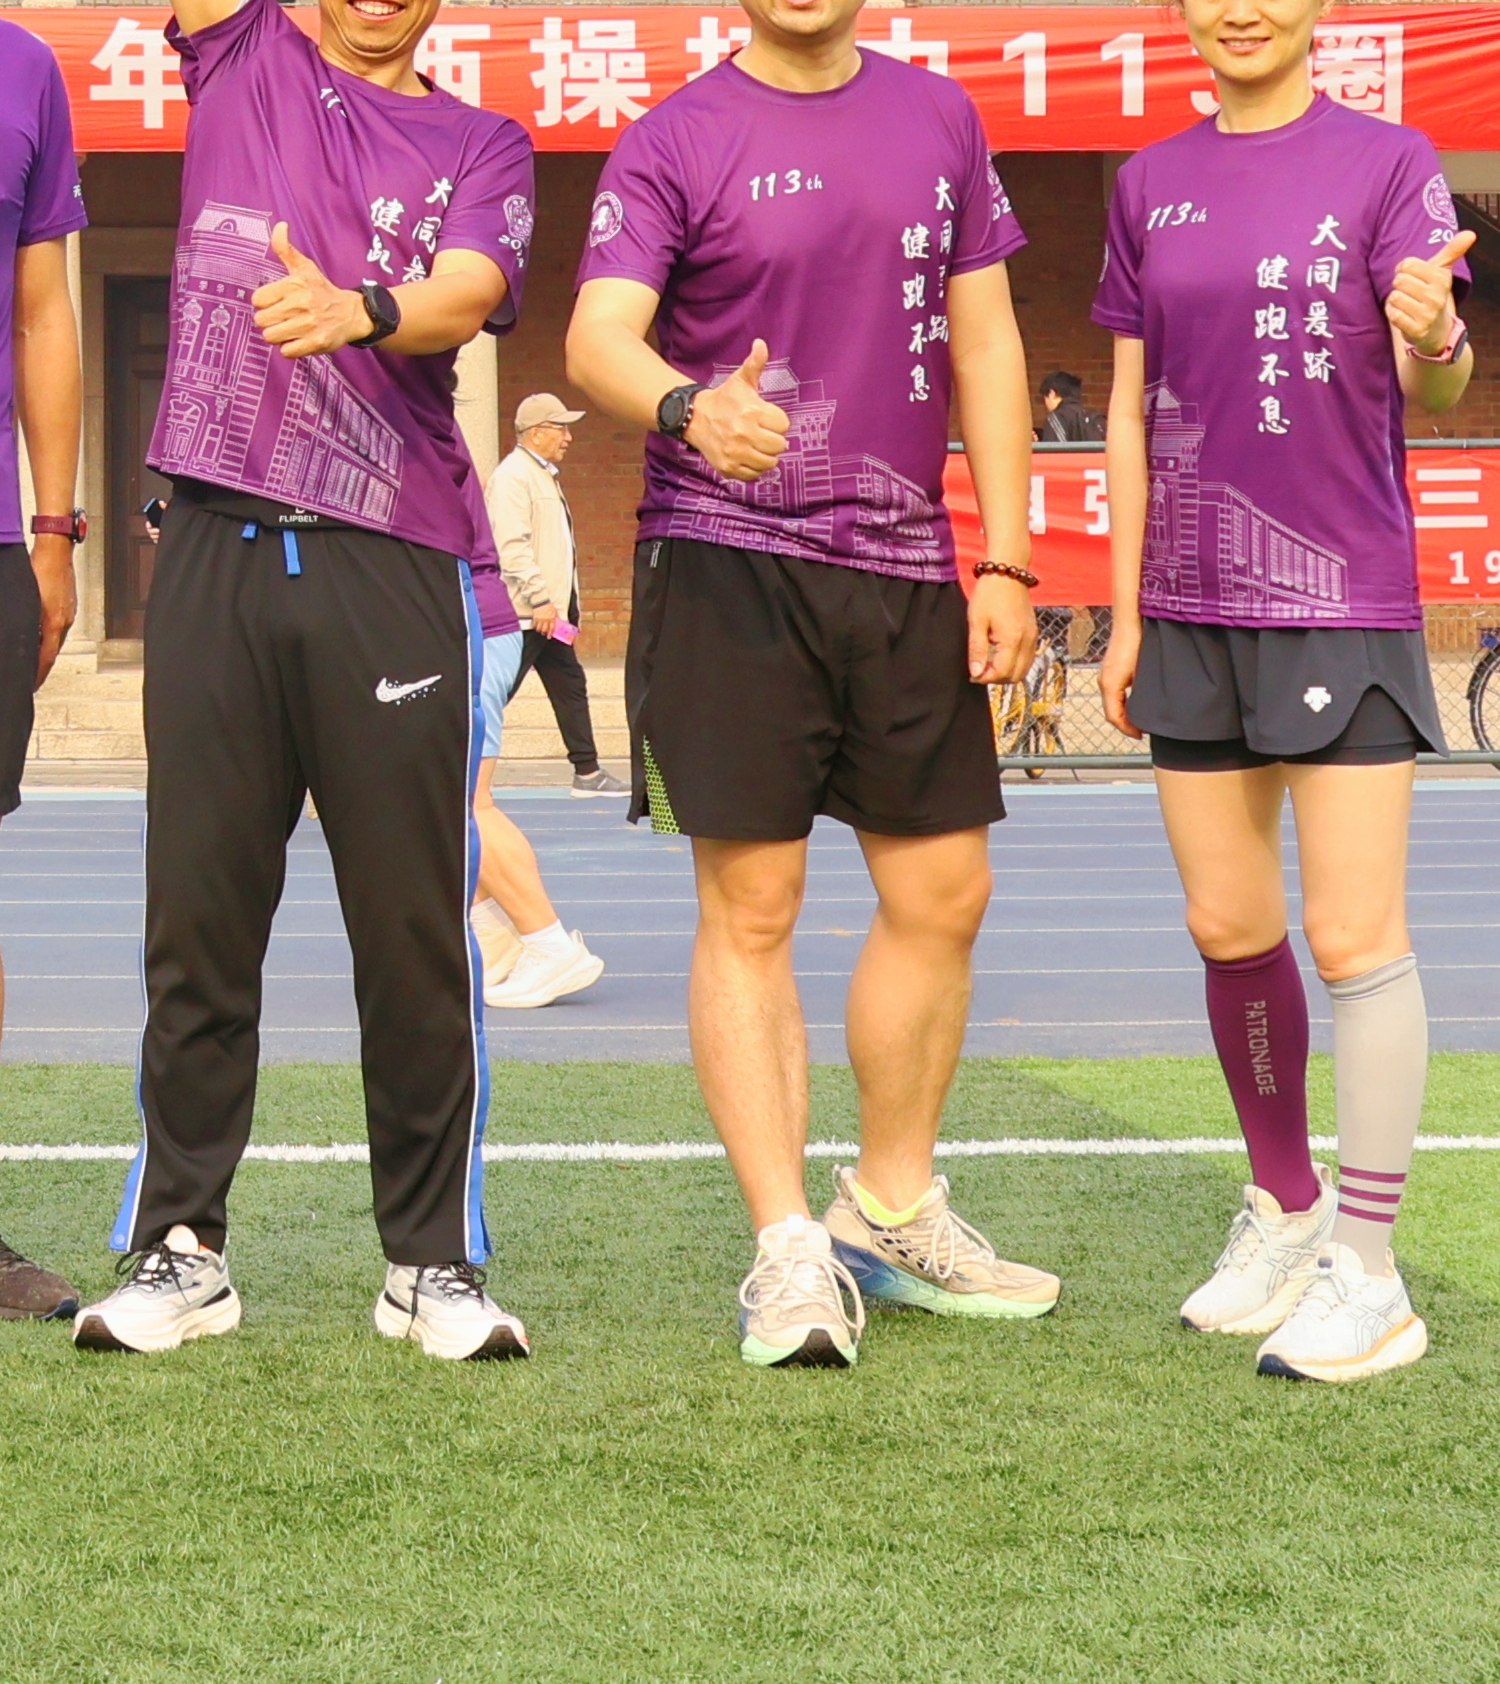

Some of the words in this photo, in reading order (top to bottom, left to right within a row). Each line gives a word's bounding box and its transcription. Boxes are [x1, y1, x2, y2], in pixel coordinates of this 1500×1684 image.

[750, 169, 823, 201] 113th
[1147, 202, 1207, 230] 113th
[1255, 254, 1291, 435] 健跑不息
[279, 515, 318, 523] FLIPBELT
[1245, 1000, 1277, 1096] PATRONAGE
